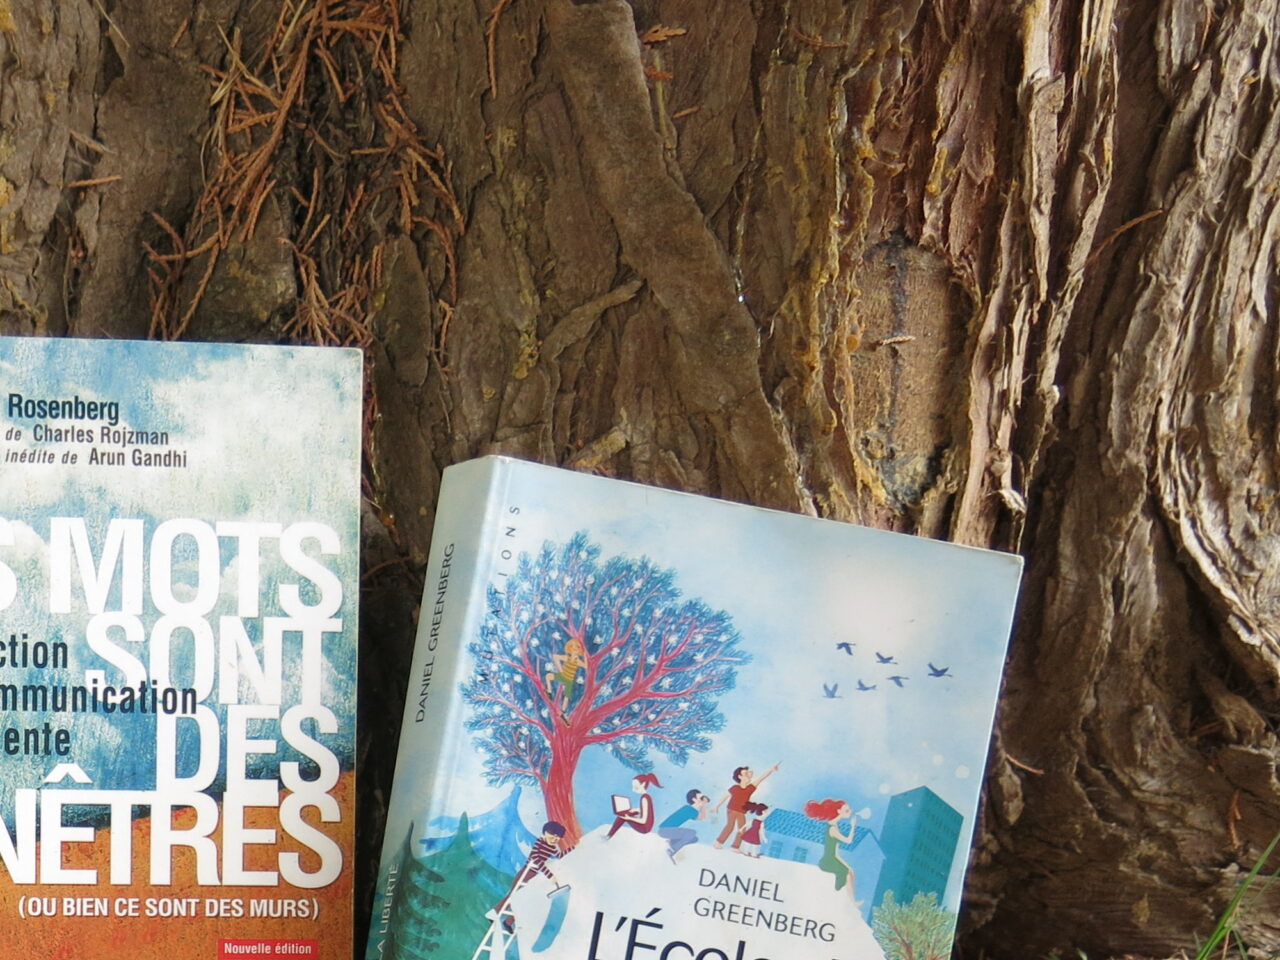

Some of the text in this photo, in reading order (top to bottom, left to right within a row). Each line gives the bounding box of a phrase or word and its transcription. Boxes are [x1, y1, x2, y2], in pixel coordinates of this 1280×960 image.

[8, 395, 120, 426] Rosenberg
[5, 427, 22, 442] de
[32, 424, 94, 444] Charles
[100, 427, 169, 448] Rojzman
[5, 447, 56, 465] inédite
[62, 449, 78, 465] de
[88, 448, 125, 467] Arun
[131, 448, 188, 469] Gandhi
[49, 517, 343, 619] MOTS
[415, 542, 455, 723] DANIEL GREENBERG
[85, 611, 343, 706] SONT
[156, 705, 340, 795] DES
[379, 863, 399, 934] LIBERTÉ
[698, 868, 784, 903] DANIEL
[18, 898, 319, 919] (OU BIEN CE SONT DES MURS)
[693, 897, 835, 942] GREENBERG
[224, 942, 312, 955] Nouvelle édition
